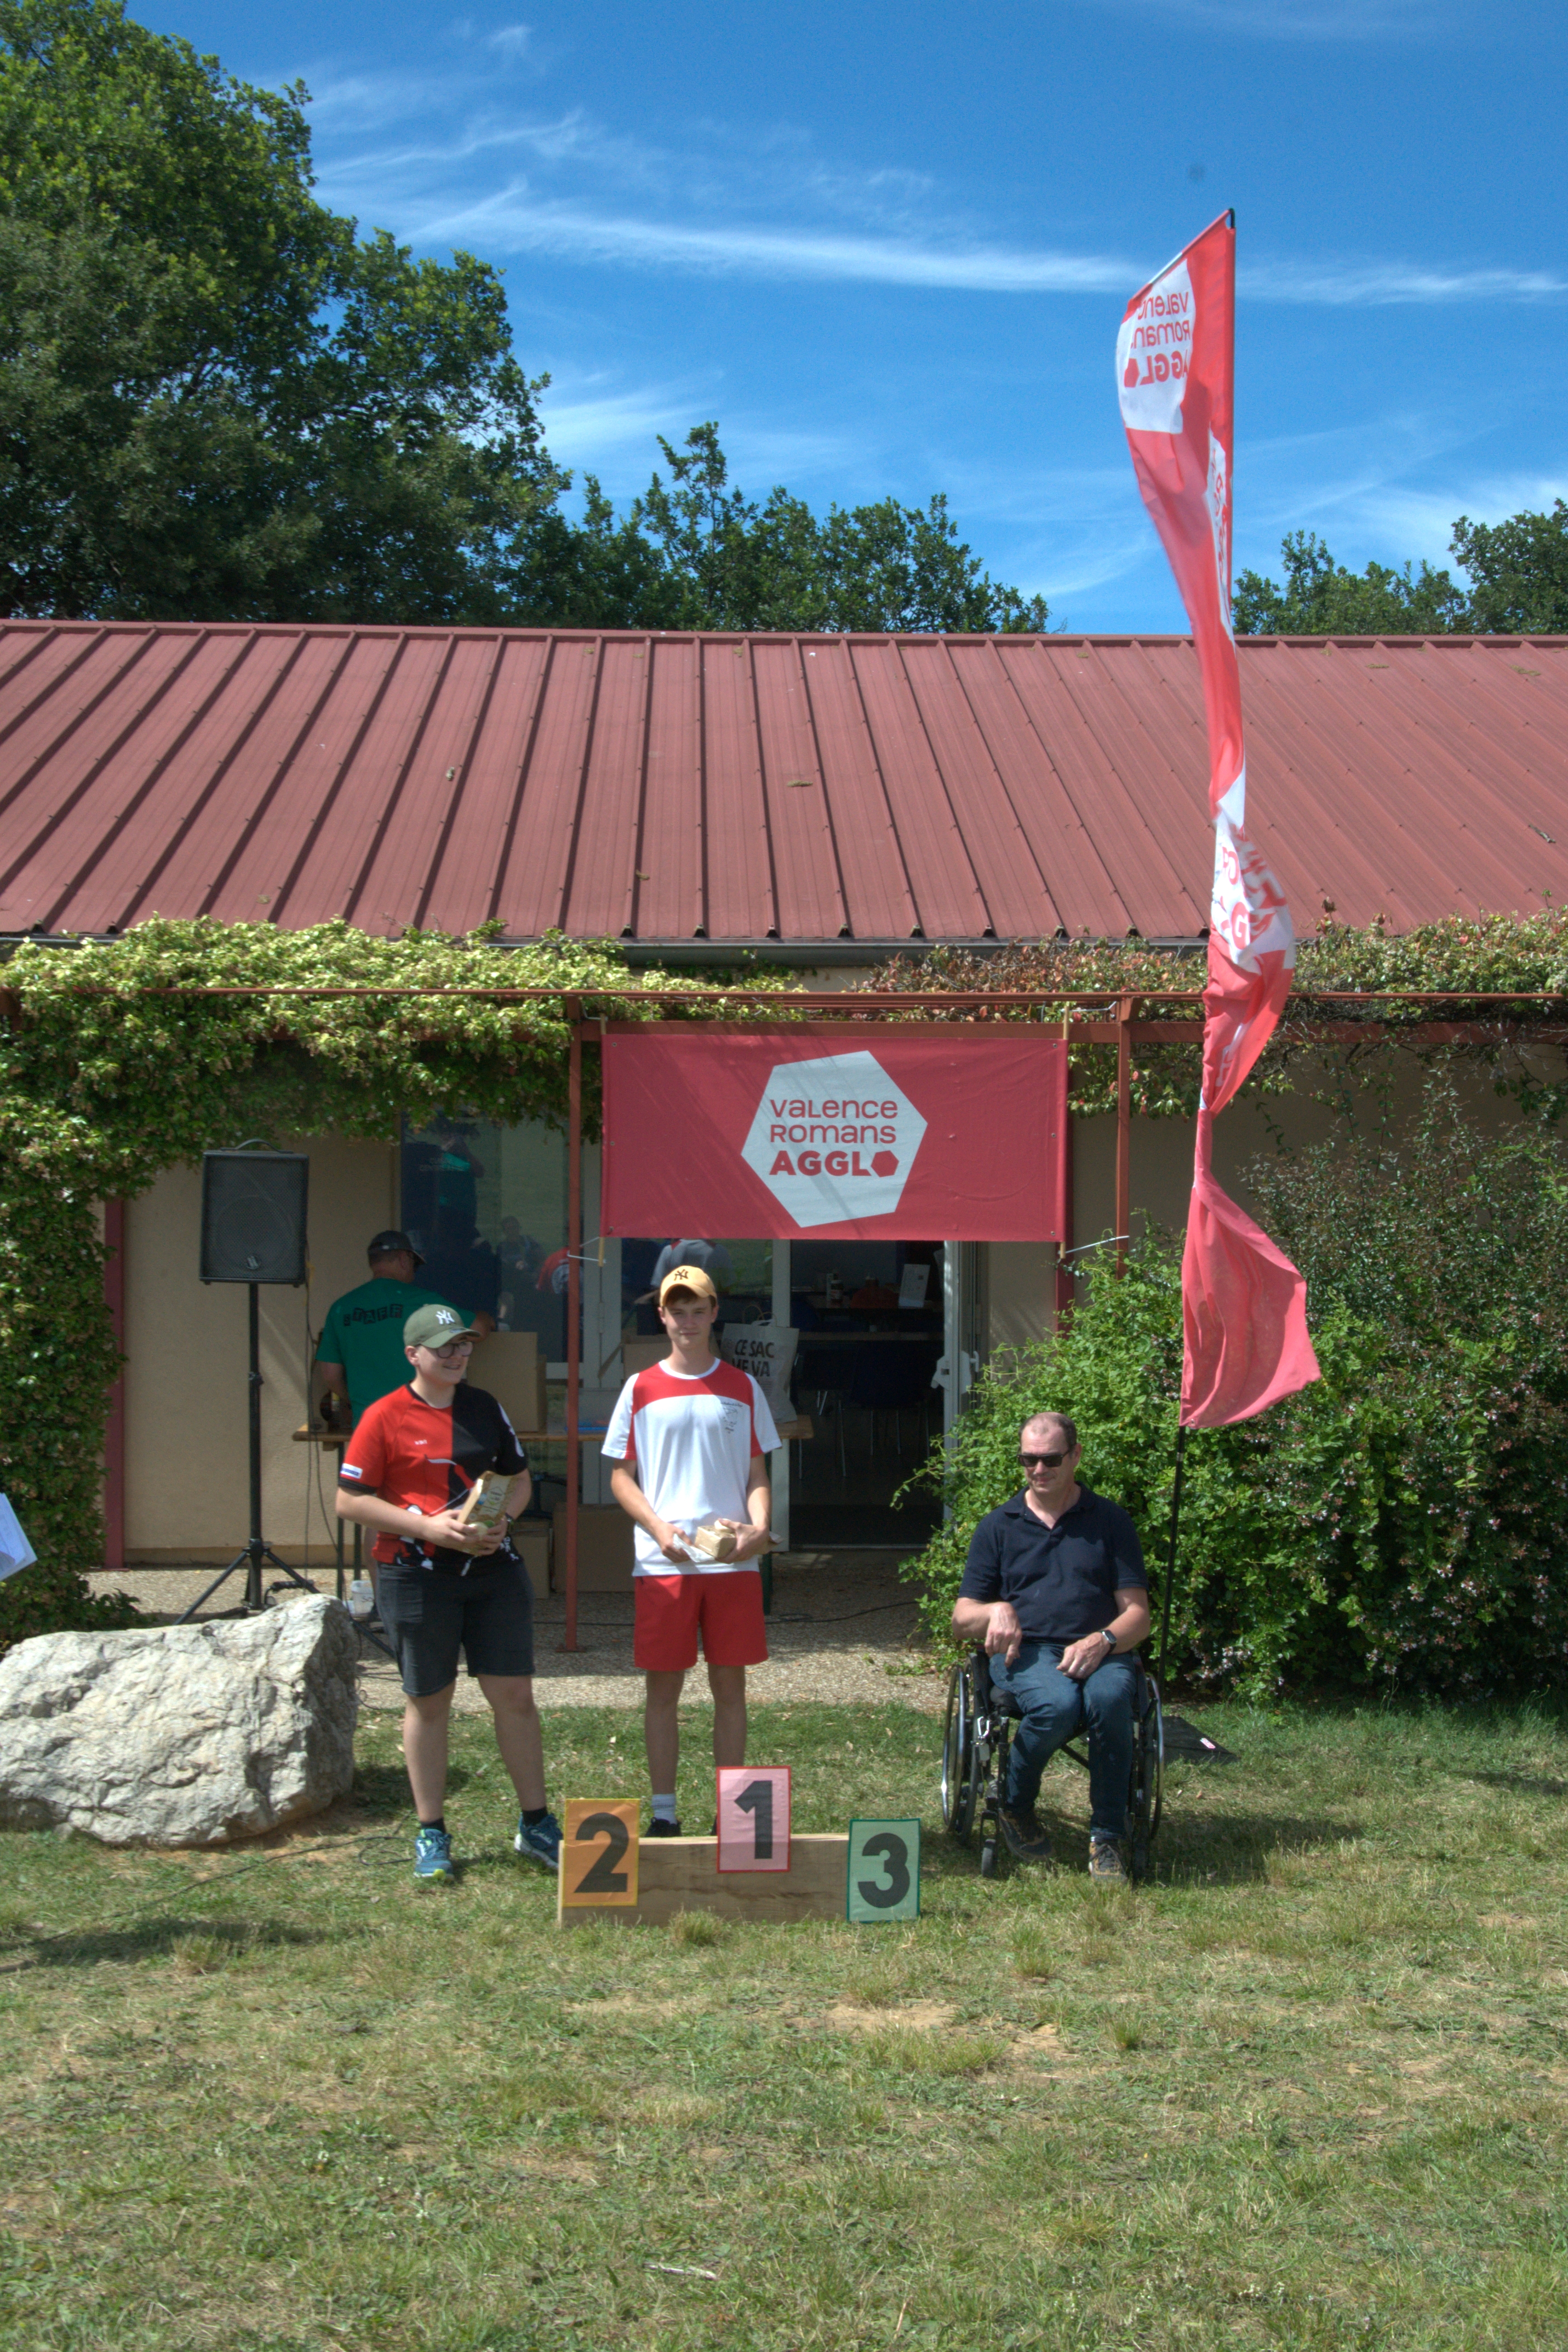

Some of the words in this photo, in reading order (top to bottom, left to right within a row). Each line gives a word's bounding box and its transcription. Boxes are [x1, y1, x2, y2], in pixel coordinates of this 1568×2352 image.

[770, 1124, 896, 1144] Romans
[436, 1309, 455, 1324] NY
[748, 1340, 775, 1358] SAC
[734, 1780, 772, 1859] 1
[574, 1812, 630, 1893] 2
[857, 1833, 910, 1908] 3
